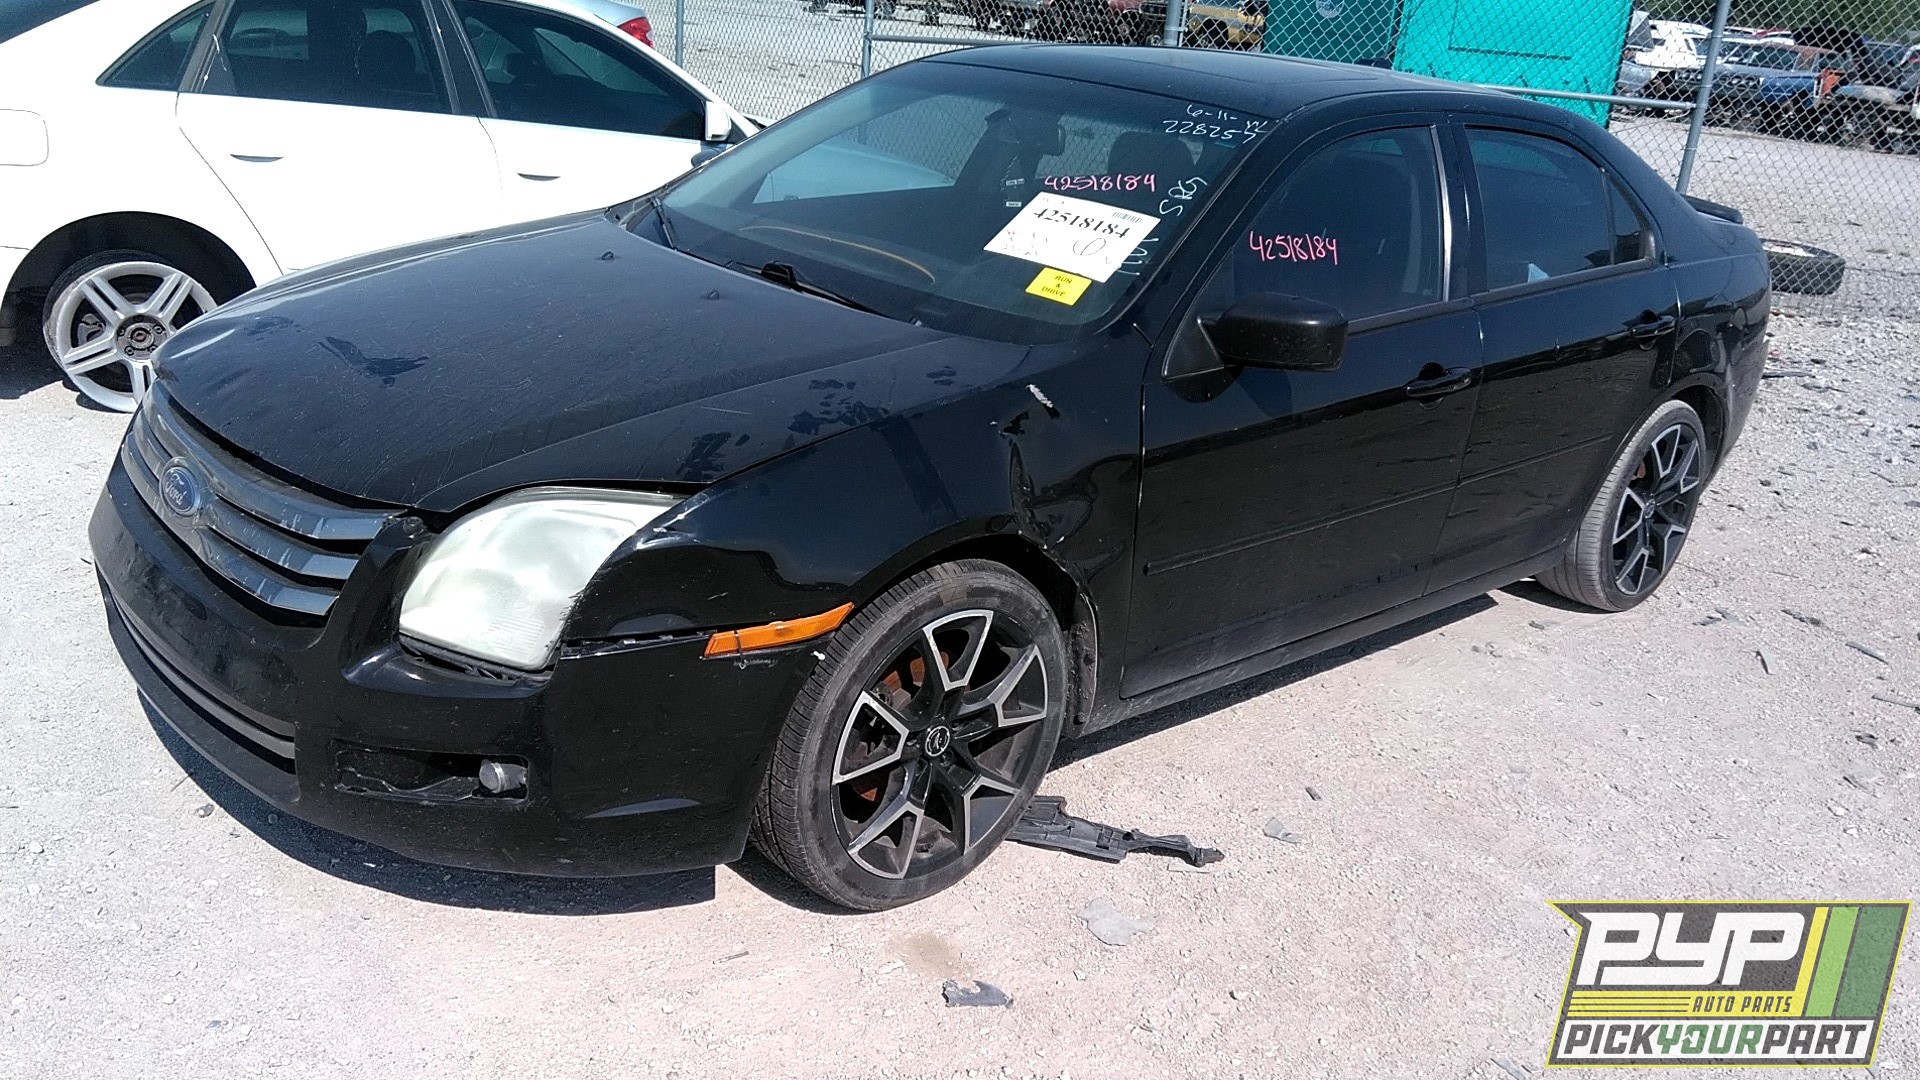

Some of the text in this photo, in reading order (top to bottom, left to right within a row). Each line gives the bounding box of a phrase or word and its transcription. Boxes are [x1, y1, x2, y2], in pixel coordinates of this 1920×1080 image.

[1044, 173, 1157, 193] 42518184
[1033, 207, 1131, 239] 42518184
[1249, 230, 1338, 266] 42518184
[1041, 286, 1067, 297] DRIVE
[1054, 275, 1073, 284] RUN
[165, 473, 188, 506] Ford
